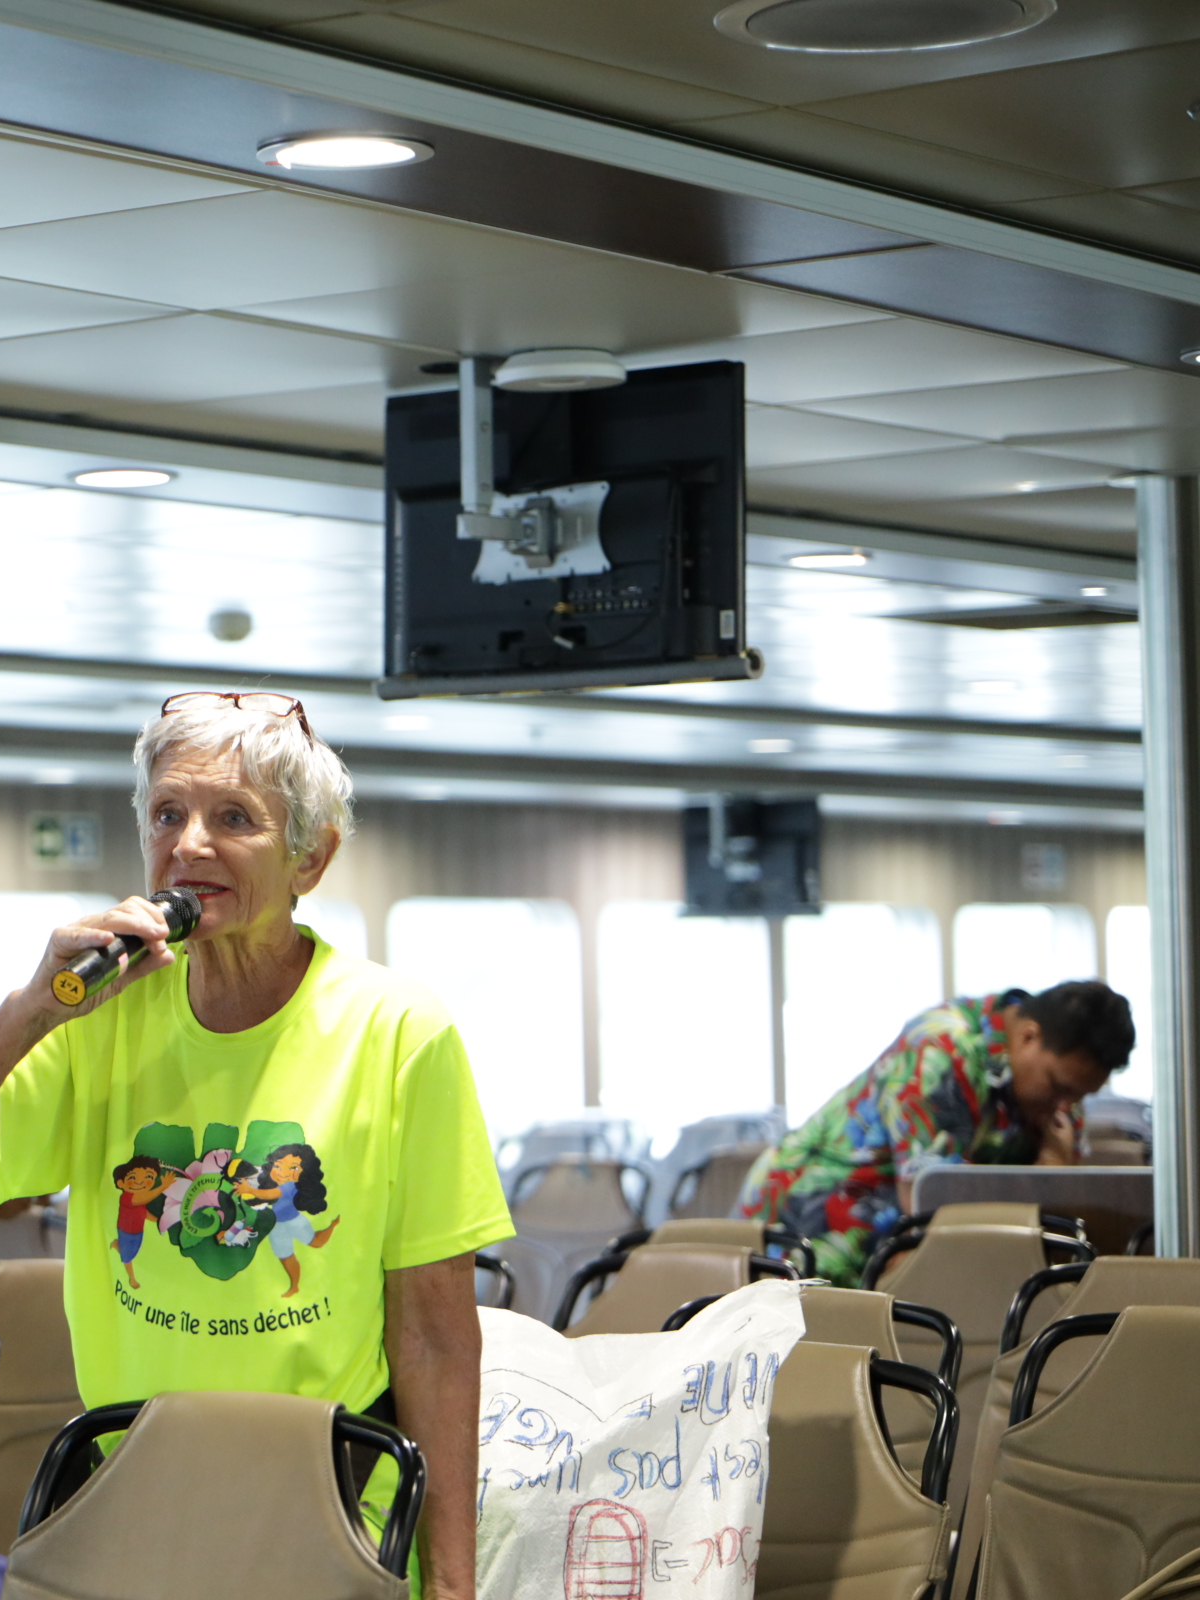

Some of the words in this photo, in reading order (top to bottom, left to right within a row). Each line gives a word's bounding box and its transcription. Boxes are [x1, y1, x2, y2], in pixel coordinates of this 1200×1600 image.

[115, 1279, 142, 1315] Pour
[145, 1306, 176, 1330] une
[180, 1310, 200, 1335] île
[208, 1318, 249, 1336] sans
[254, 1303, 321, 1333] déchet
[608, 1414, 681, 1499] pas
